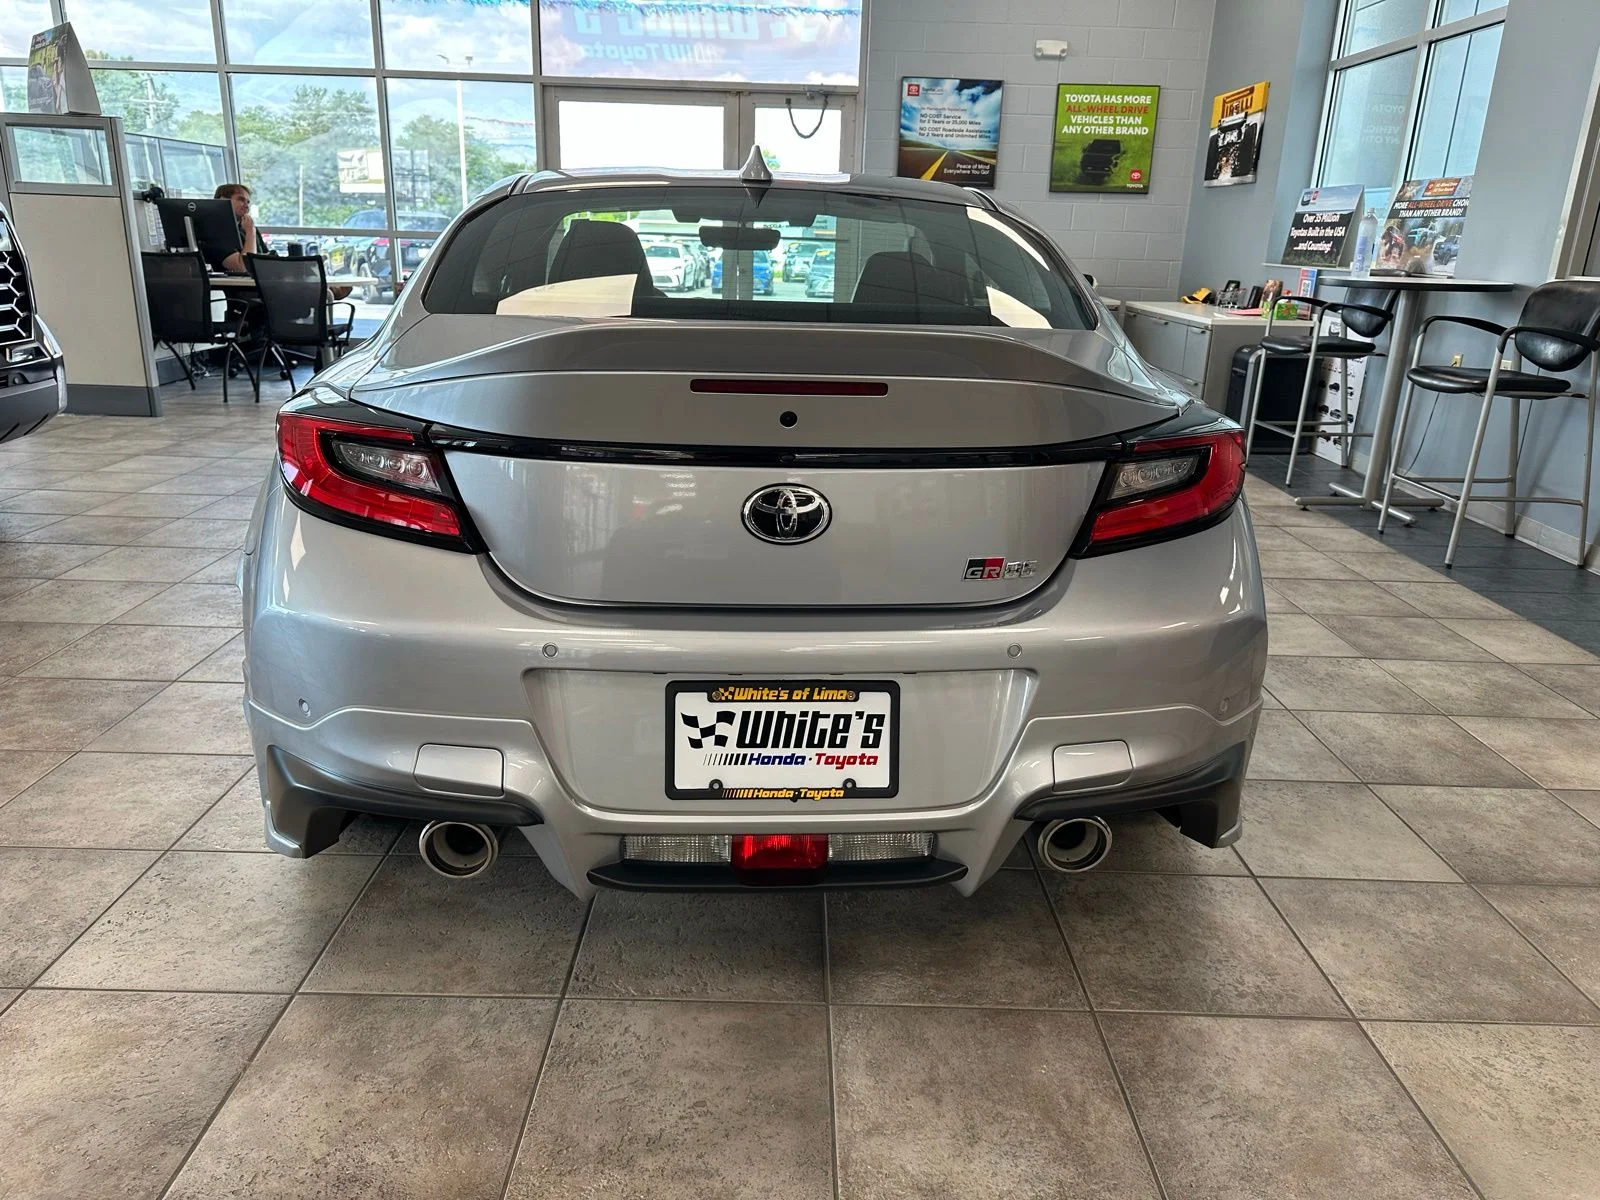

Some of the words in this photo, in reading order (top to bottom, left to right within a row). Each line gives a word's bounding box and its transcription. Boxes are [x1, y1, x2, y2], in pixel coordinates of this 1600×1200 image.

[1065, 94, 1101, 103] TOYOTA
[1103, 95, 1122, 103] HAS
[1124, 96, 1152, 104] MORE
[1066, 104, 1118, 113] ALL-WHEEL
[1071, 115, 1113, 124] VEHICLES
[1116, 116, 1142, 124] THAN
[1062, 125, 1081, 133] ANY
[1083, 126, 1114, 134] OTHER
[1116, 126, 1148, 135] BRAND
[1408, 201, 1436, 209] ALL-WHEEL
[1441, 208, 1463, 216] BRAND!
[1303, 214, 1315, 223] Over
[1321, 214, 1340, 222] Million
[1290, 227, 1307, 238] Toyotas
[1307, 227, 1319, 236] Built
[1319, 227, 1324, 236] in
[1325, 226, 1333, 236] the
[1334, 227, 1346, 236] USA
[1308, 240, 1333, 253] Counting!
[734, 688, 788, 700] White's
[792, 688, 809, 700] of
[813, 688, 848, 700] Lima
[736, 711, 885, 748] White's
[748, 753, 806, 765] Honda
[815, 753, 878, 769] Toyota
[754, 788, 794, 798] Honda
[800, 788, 844, 800] Toyota
